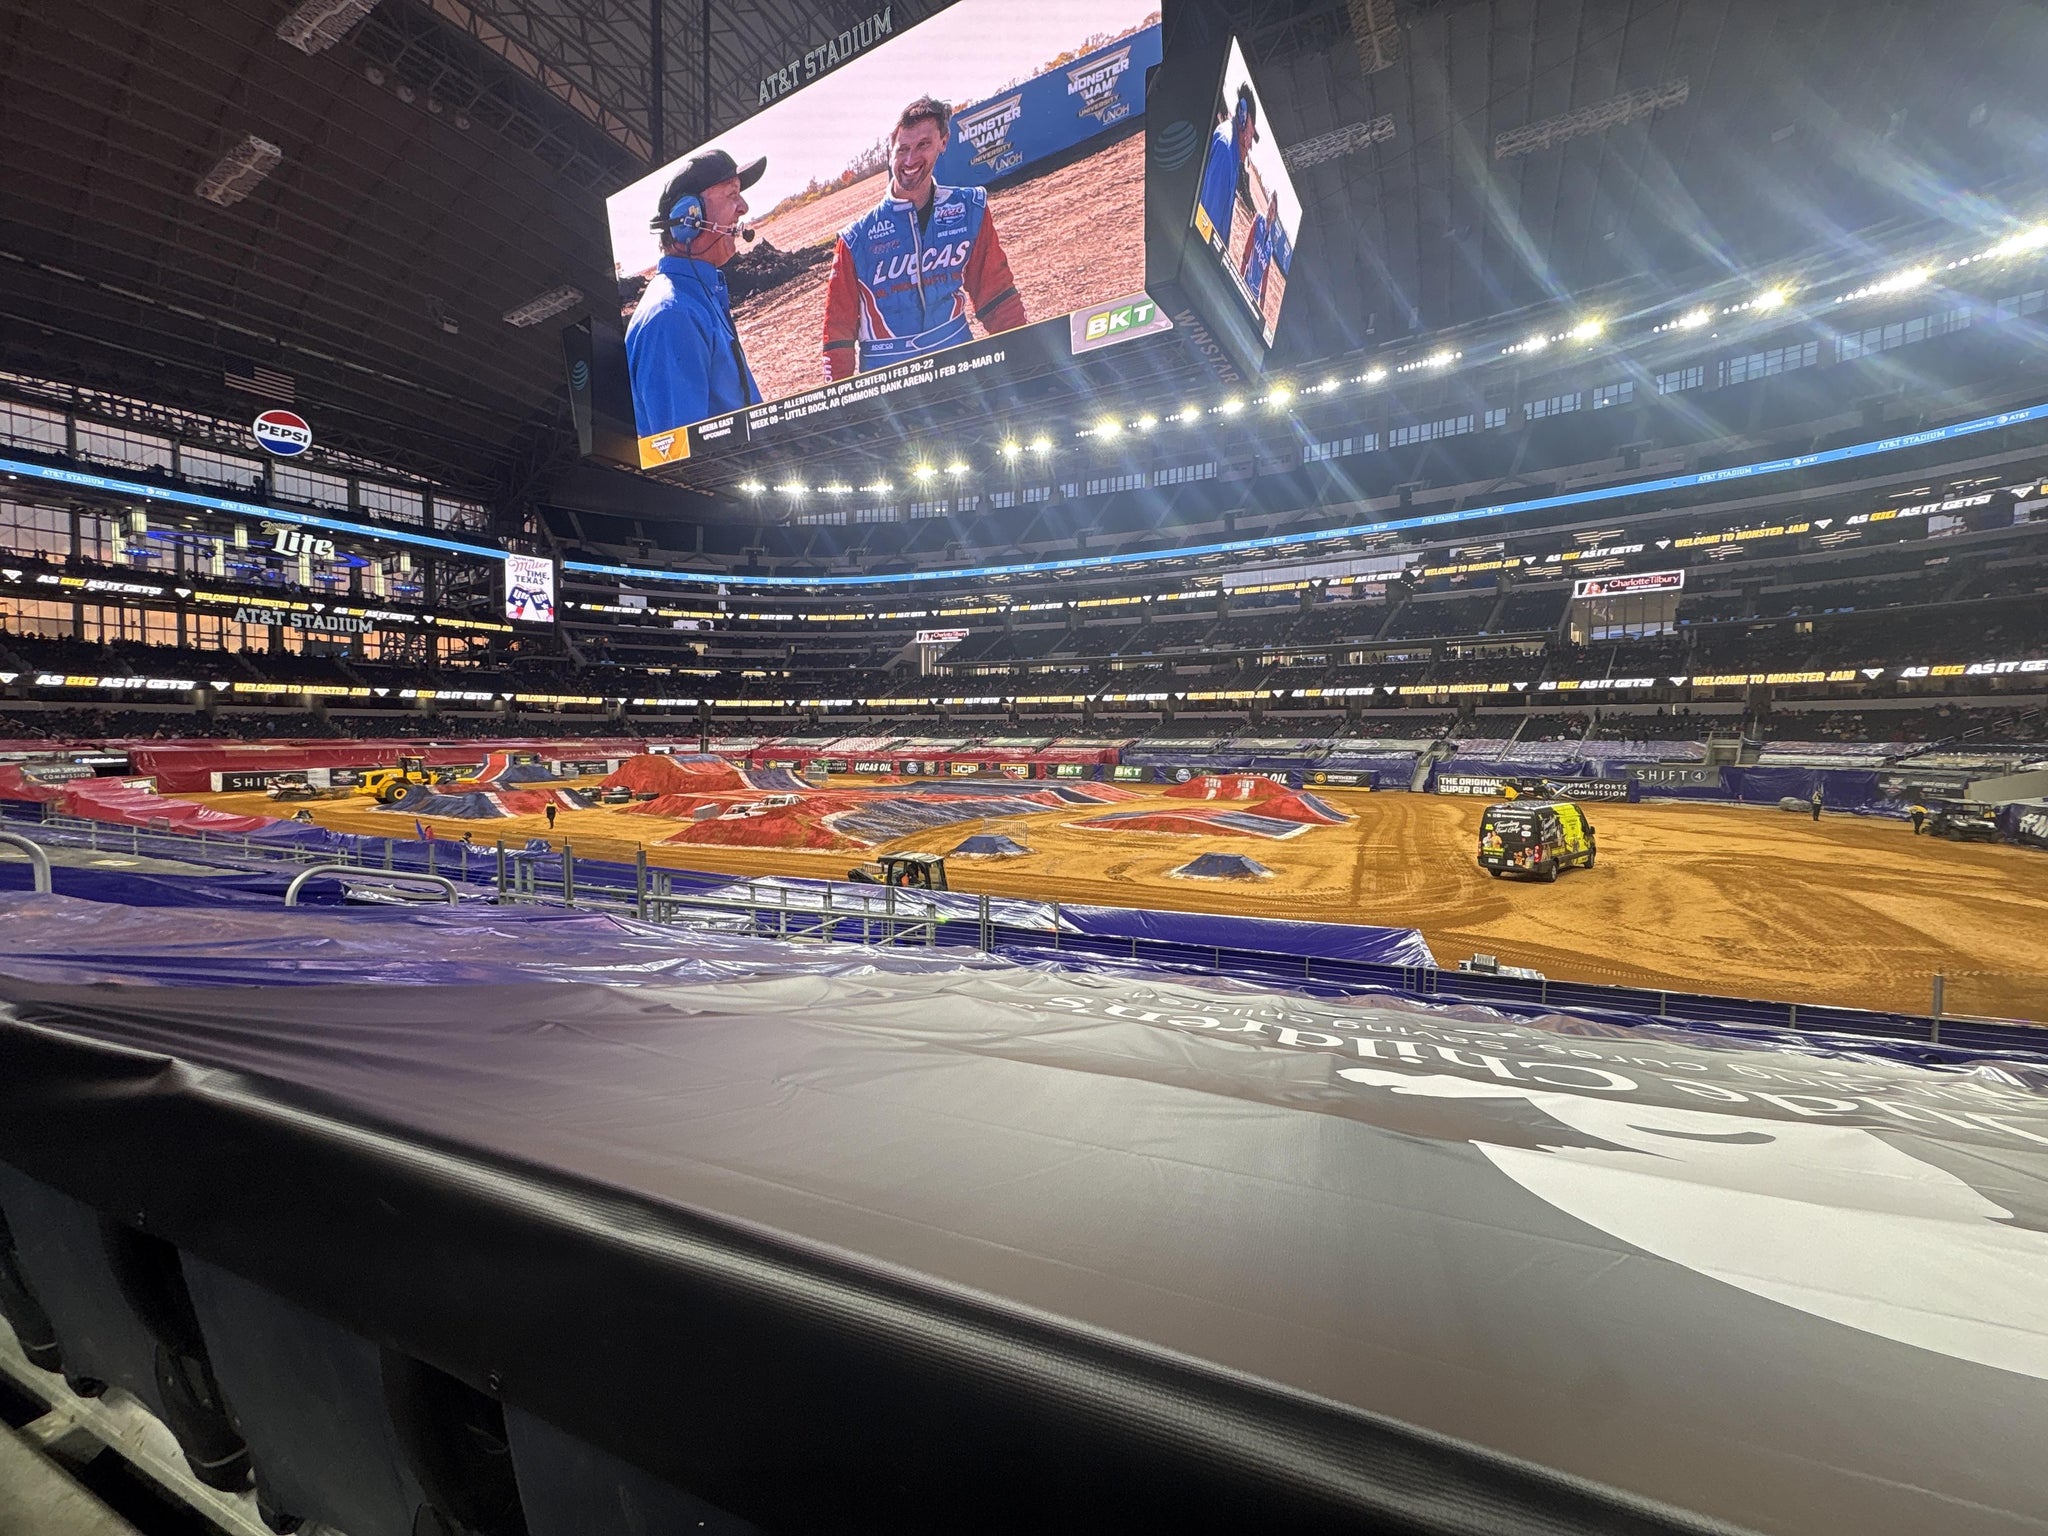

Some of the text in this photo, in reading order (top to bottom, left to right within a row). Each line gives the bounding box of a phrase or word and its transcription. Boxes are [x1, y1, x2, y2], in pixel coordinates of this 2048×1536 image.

[758, 6, 893, 107] AT&T STADIUM
[1068, 57, 1130, 96] MONSTER
[1083, 80, 1113, 99] JAM
[1078, 94, 1121, 117] UNIVERSITY
[958, 105, 1022, 144] MONSTER
[975, 129, 1005, 147] JAM
[970, 142, 1013, 166] UNIVERSITY
[995, 151, 1023, 172] UNOH
[867, 220, 895, 237] MAC
[873, 240, 971, 286] LUCAS
[1087, 303, 1154, 336] BKT
[1173, 308, 1240, 384] WINSTAR
[749, 358, 934, 420] WEEK 08 ALLENTOWN, PA (PPL CENTER) FEB 20-22
[750, 350, 1006, 430] WEEK 09 LITTLE ROCK, AR (SIMMONS BANK ARENA) FEB 28-MAR 01
[718, 416, 734, 428] EAST
[2008, 411, 2030, 422] AT&T
[257, 422, 309, 444] PEPSI
[1877, 430, 1946, 450] AT&T STADIUM
[66, 473, 105, 486] STADIUM
[1846, 494, 1994, 525] AS BIG AS IT GETS!
[271, 528, 334, 557] Lite
[1674, 522, 1810, 548] WELCOME TO MONSTER JAM
[1545, 554, 1561, 563] AS
[1580, 550, 1597, 559] AS
[1596, 547, 1610, 557] IT
[527, 570, 550, 581] TIME,
[1424, 566, 1458, 577] WELCOME
[1458, 565, 1468, 574] TO
[36, 574, 60, 584] AS
[86, 579, 107, 590] AS
[514, 575, 544, 585] TEXAS
[195, 592, 238, 604] WELCOME
[239, 596, 250, 605] TO
[234, 607, 374, 634] AT&T STADIUM
[1901, 661, 2020, 677] AS BIG AS IT
[35, 675, 197, 690] AS BIG AS IT GETS!
[1538, 681, 1557, 690] AS
[1579, 680, 1600, 689] AS
[1598, 679, 1615, 688] IT
[1614, 677, 1656, 688] GETS!
[1692, 669, 1856, 686] WELCOME TO MONSTER JAM
[234, 682, 288, 693] WELCOME
[288, 684, 302, 694] TO
[400, 689, 417, 698] AS
[435, 691, 453, 699] AS
[1399, 685, 1437, 695] WELCOME
[1437, 685, 1448, 694] TO
[854, 762, 879, 772] LUCAS
[879, 762, 892, 772] OIL
[953, 765, 977, 774] JCB
[1057, 764, 1083, 775] BKT
[1114, 766, 1142, 777] BKT
[1440, 777, 1502, 787] THE ORIGINAL
[1636, 770, 1689, 781] SHIFT
[1440, 785, 1497, 795] SUPER GLUE
[1567, 789, 1627, 797] COMMISSION
[1594, 783, 1627, 791] SPORTS
